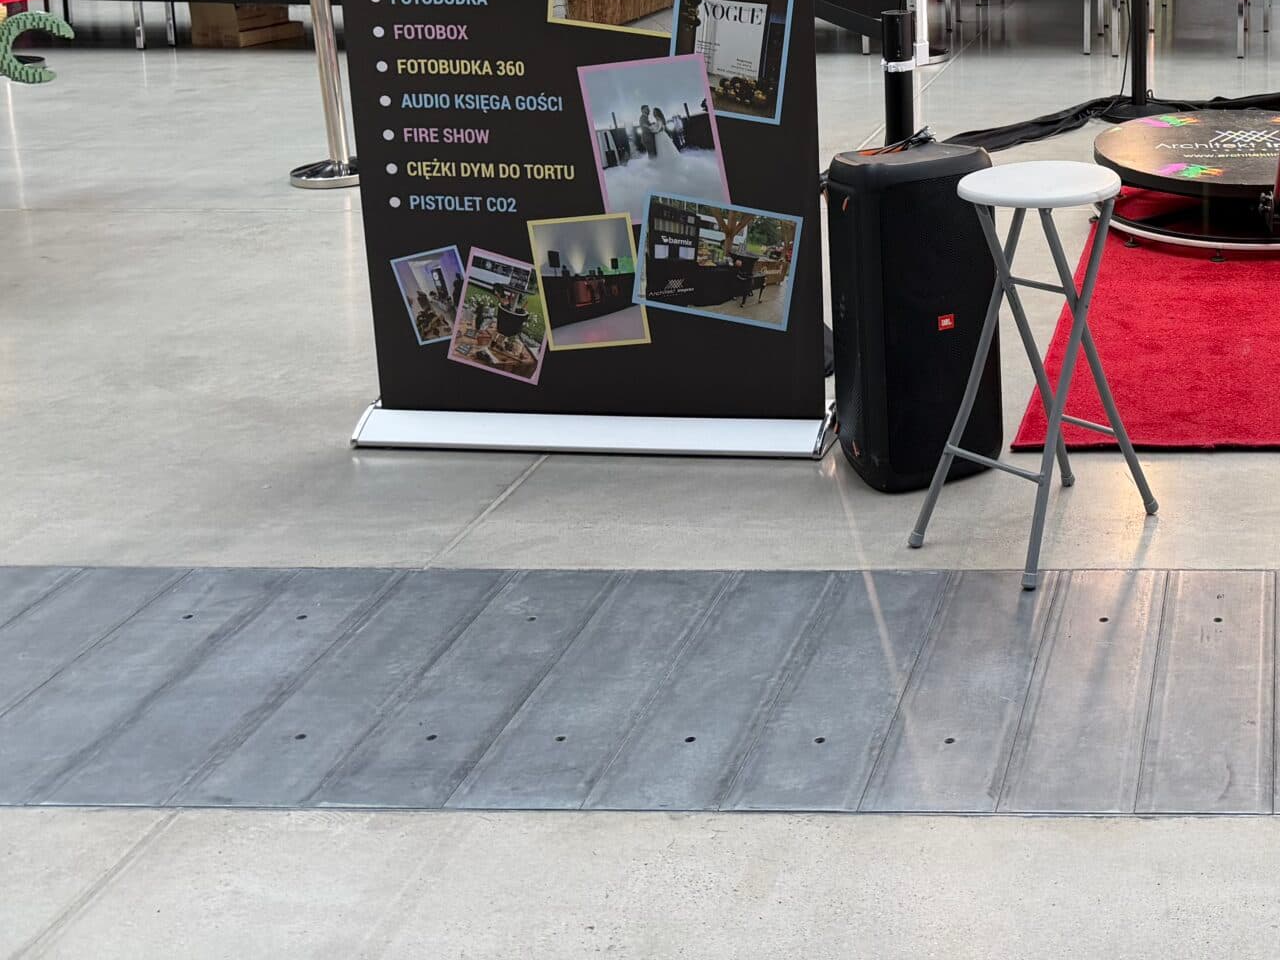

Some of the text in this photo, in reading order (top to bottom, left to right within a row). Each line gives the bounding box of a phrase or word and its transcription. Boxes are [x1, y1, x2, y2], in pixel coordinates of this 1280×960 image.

[703, 1, 763, 26] VOGUE
[394, 25, 468, 39] FOTOBOX
[397, 59, 524, 76] FOTOBUDKA 360
[402, 93, 562, 113] AUDIO KSIĘGA GOŚCI
[404, 128, 489, 143] FIRE SHOW
[407, 159, 574, 179] CIĘŻKI DYM DO TORTU
[410, 196, 516, 212] PISTOLET CO2
